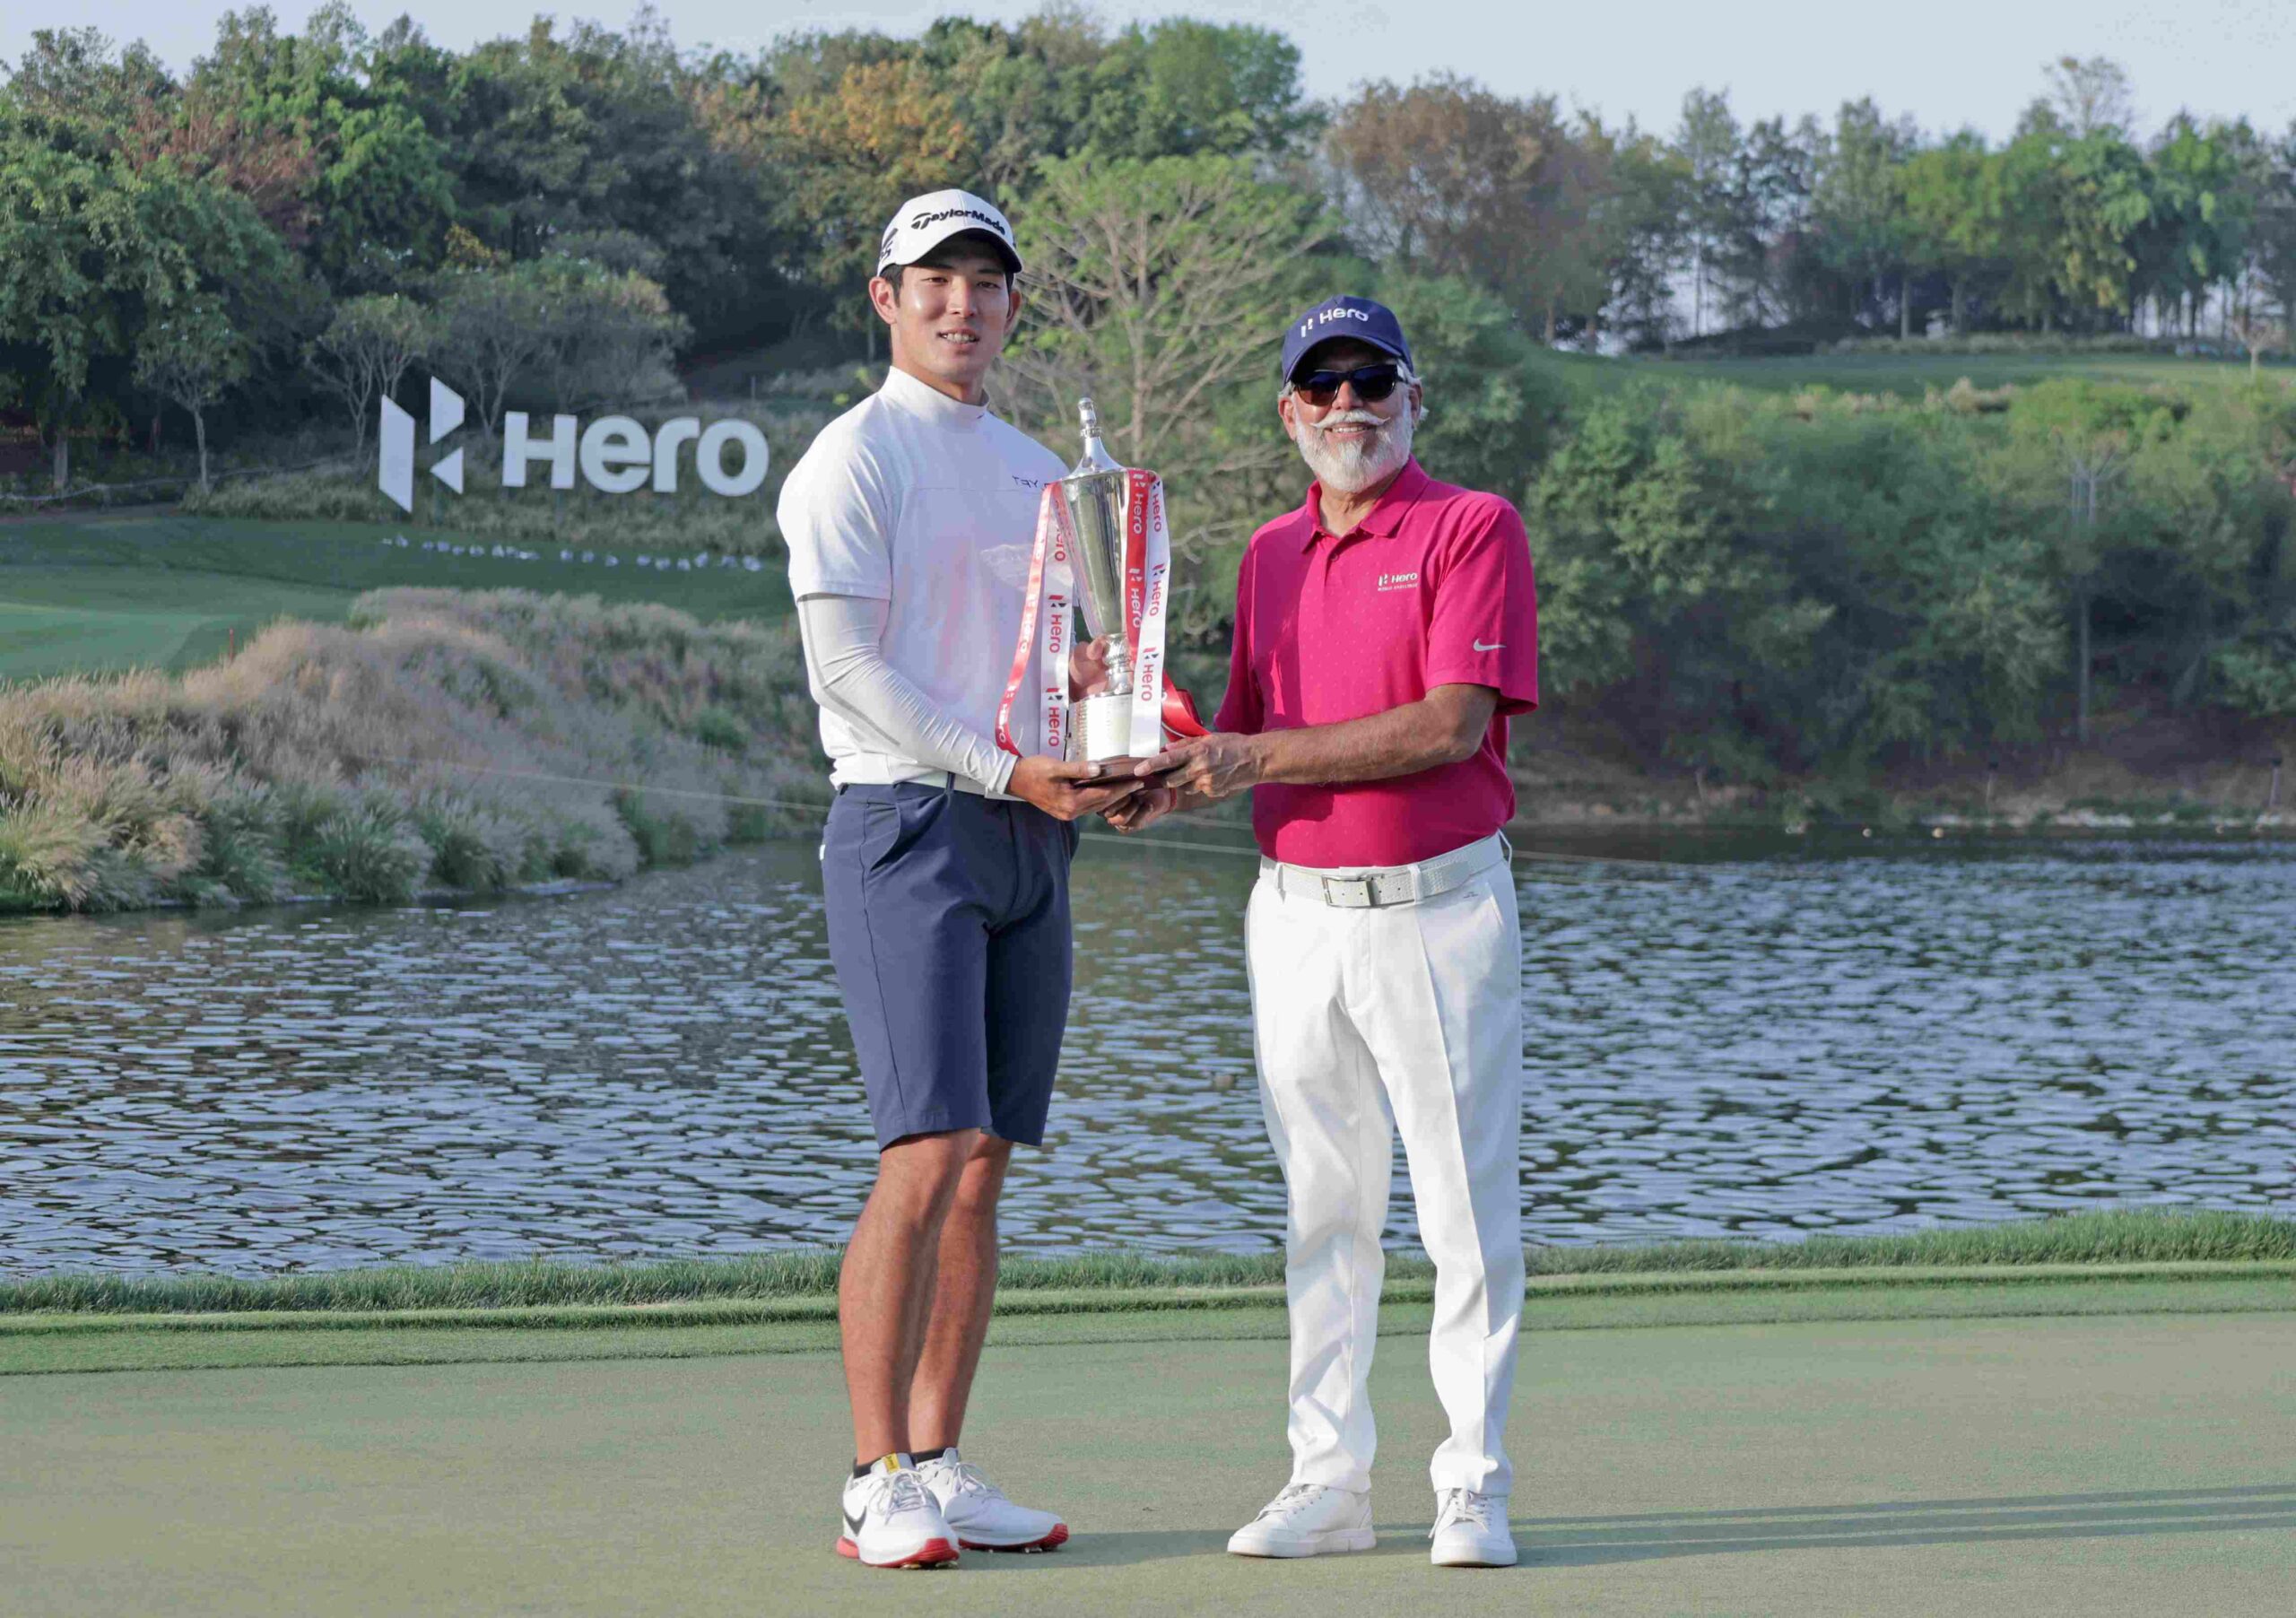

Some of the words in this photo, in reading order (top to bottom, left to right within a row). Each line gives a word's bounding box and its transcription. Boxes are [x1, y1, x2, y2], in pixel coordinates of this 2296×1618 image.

[910, 208, 1005, 235] TaylorMade
[1319, 299, 1370, 325] Hero
[502, 411, 770, 497] Hero
[1133, 493, 1144, 535] Hero
[1152, 494, 1162, 533] Hero
[1391, 572, 1418, 583] Hero
[1131, 587, 1143, 628] Hero
[1149, 579, 1162, 616] Hero
[1049, 614, 1063, 654] Hero
[1141, 664, 1154, 701] Hero
[1048, 707, 1060, 747] Hero
